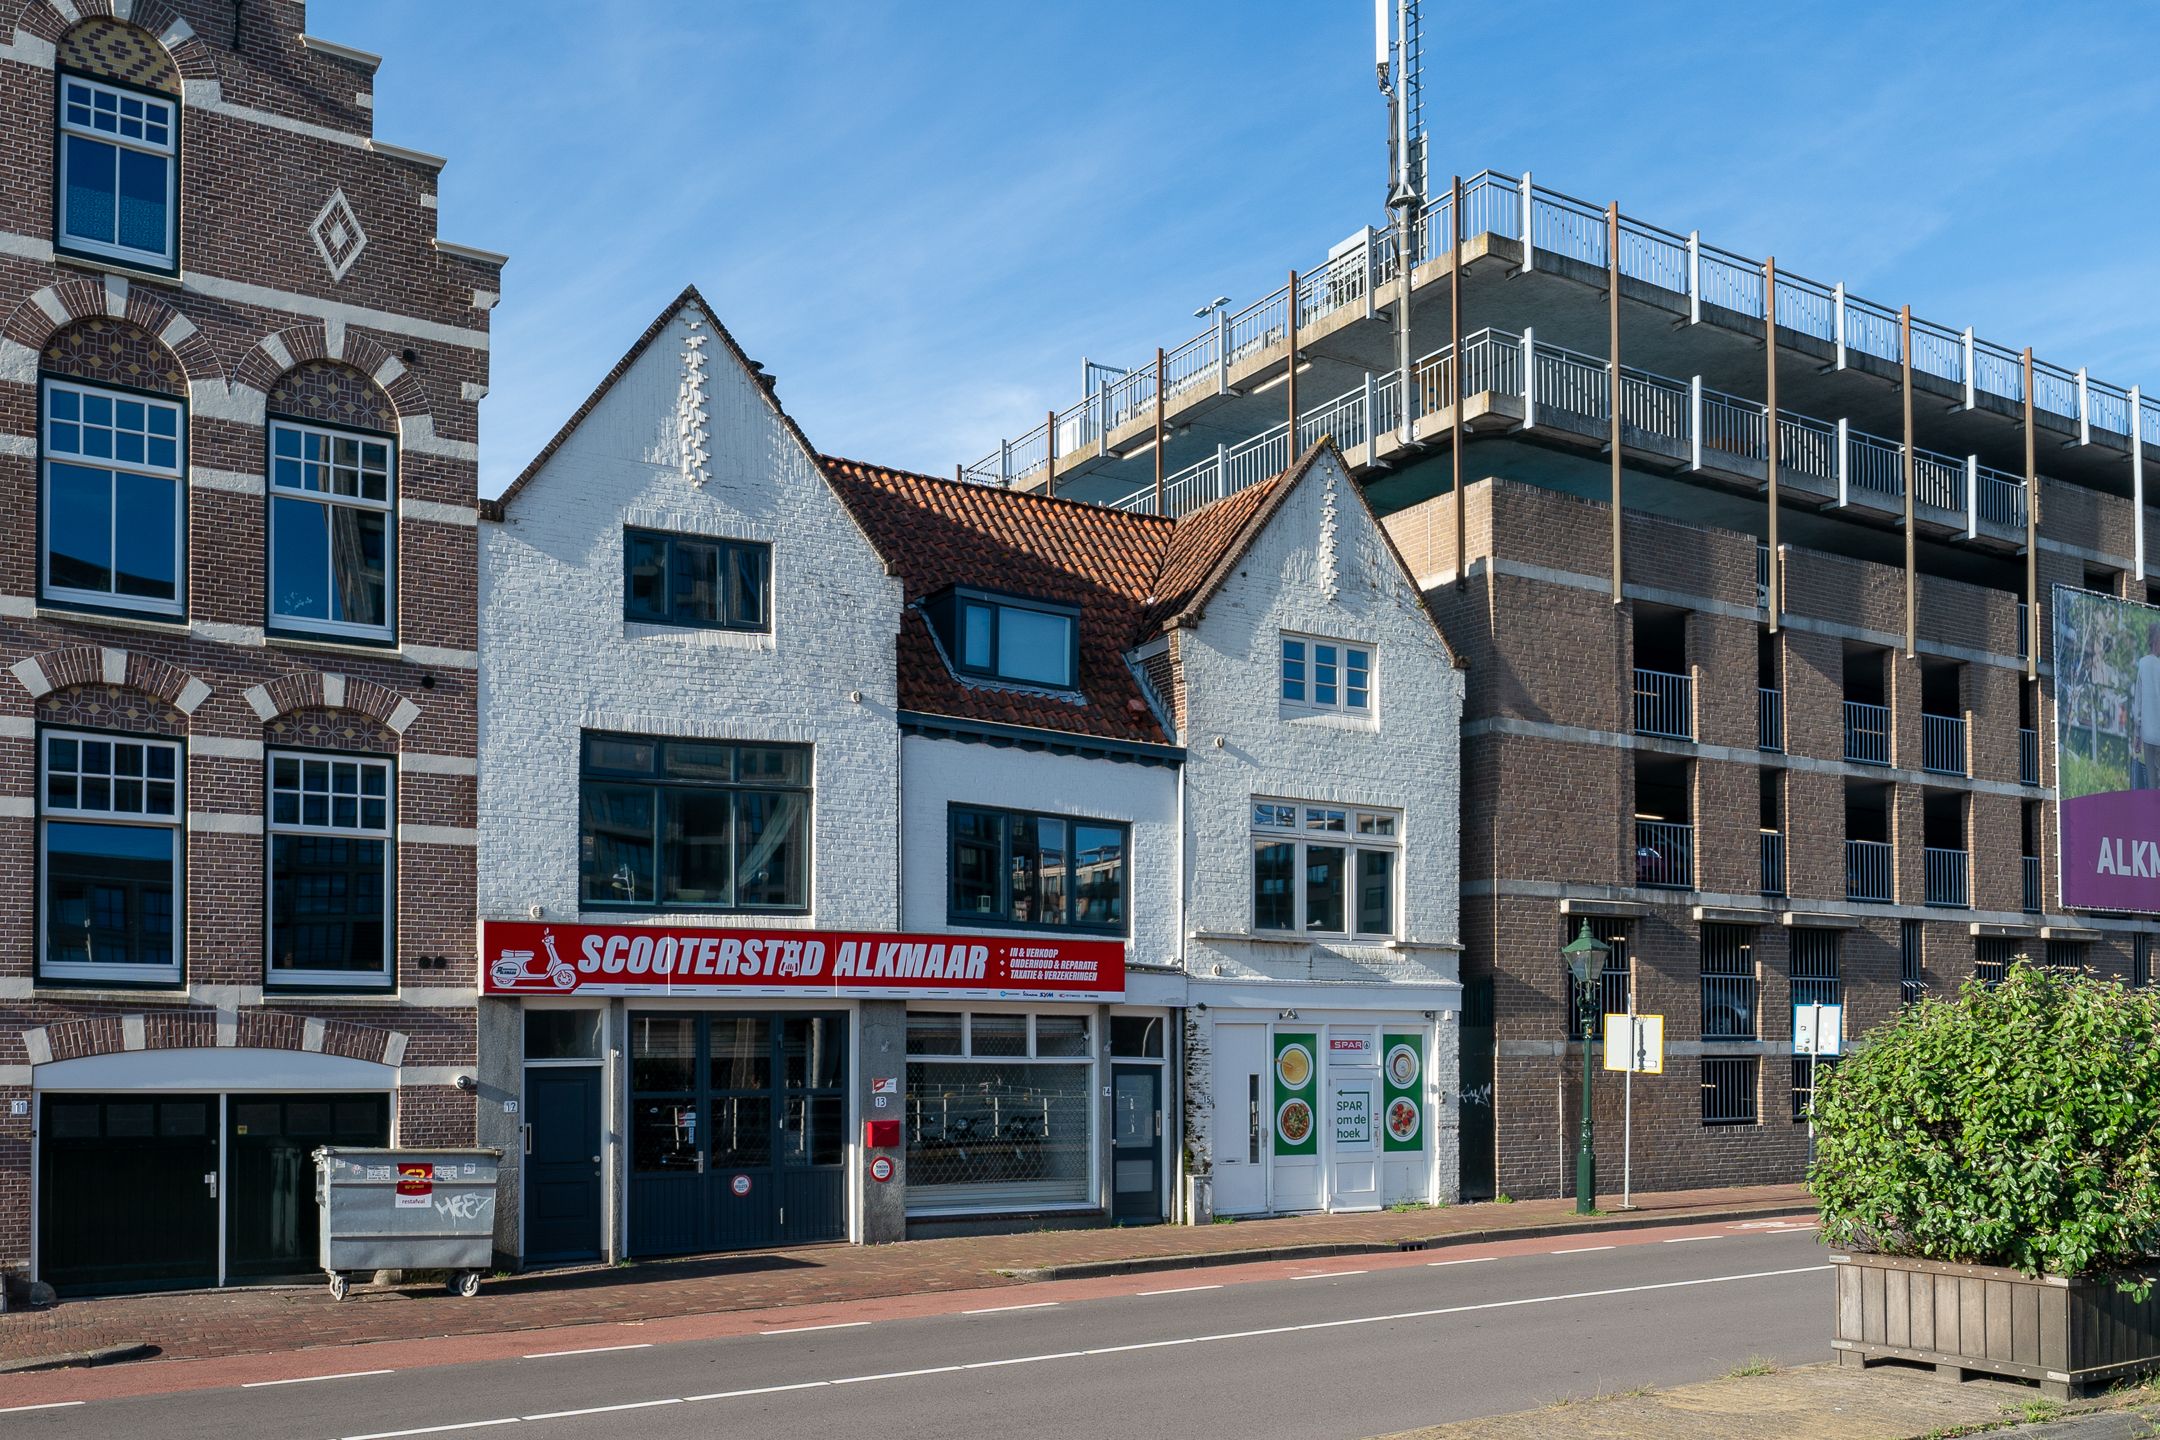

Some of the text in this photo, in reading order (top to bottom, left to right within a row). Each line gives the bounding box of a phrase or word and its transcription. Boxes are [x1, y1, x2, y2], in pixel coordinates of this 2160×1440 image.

[577, 934, 990, 980] SCOOTERSTAD ALKMAAR
[1009, 947, 1059, 958] IN & VERKOOP
[1010, 959, 1099, 971] ONDERHOUD & REPARATIE
[1010, 970, 1099, 981] TAXATIE & VERZEKERINGEN
[1334, 1041, 1362, 1049] SPAR
[1103, 1087, 1111, 1095] 14
[876, 1097, 886, 1107] 13
[1203, 1095, 1212, 1104] 15
[15, 1102, 26, 1113] 11
[506, 1102, 516, 1112] 12
[1336, 1100, 1363, 1111] SPAR
[1336, 1114, 1367, 1125] om de
[1336, 1127, 1361, 1139] hoek
